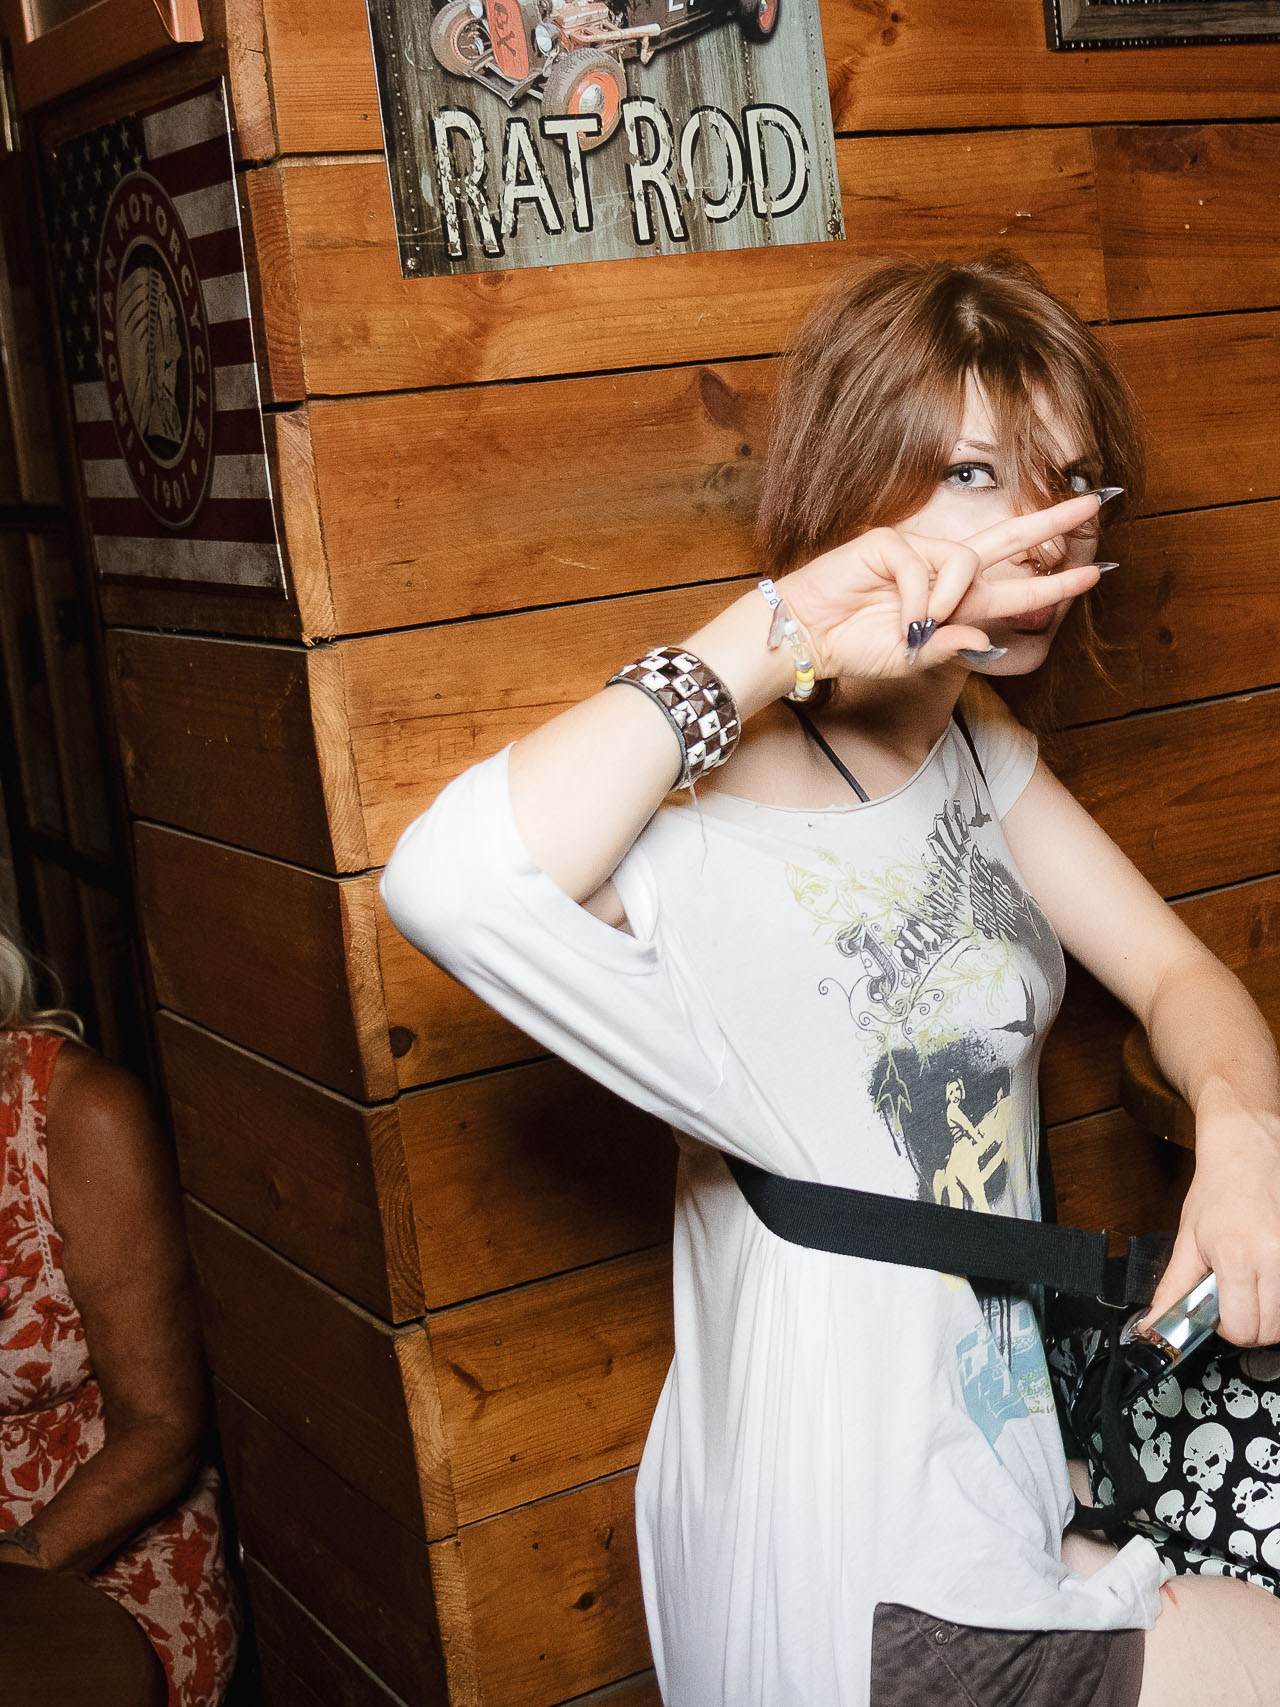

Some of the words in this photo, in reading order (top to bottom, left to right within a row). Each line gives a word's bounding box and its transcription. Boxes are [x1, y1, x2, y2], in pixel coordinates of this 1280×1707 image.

[429, 105, 602, 260] RAT
[620, 96, 810, 244] ROD
[103, 245, 135, 450] INDIAN
[115, 192, 208, 448] MOTORCYCLE
